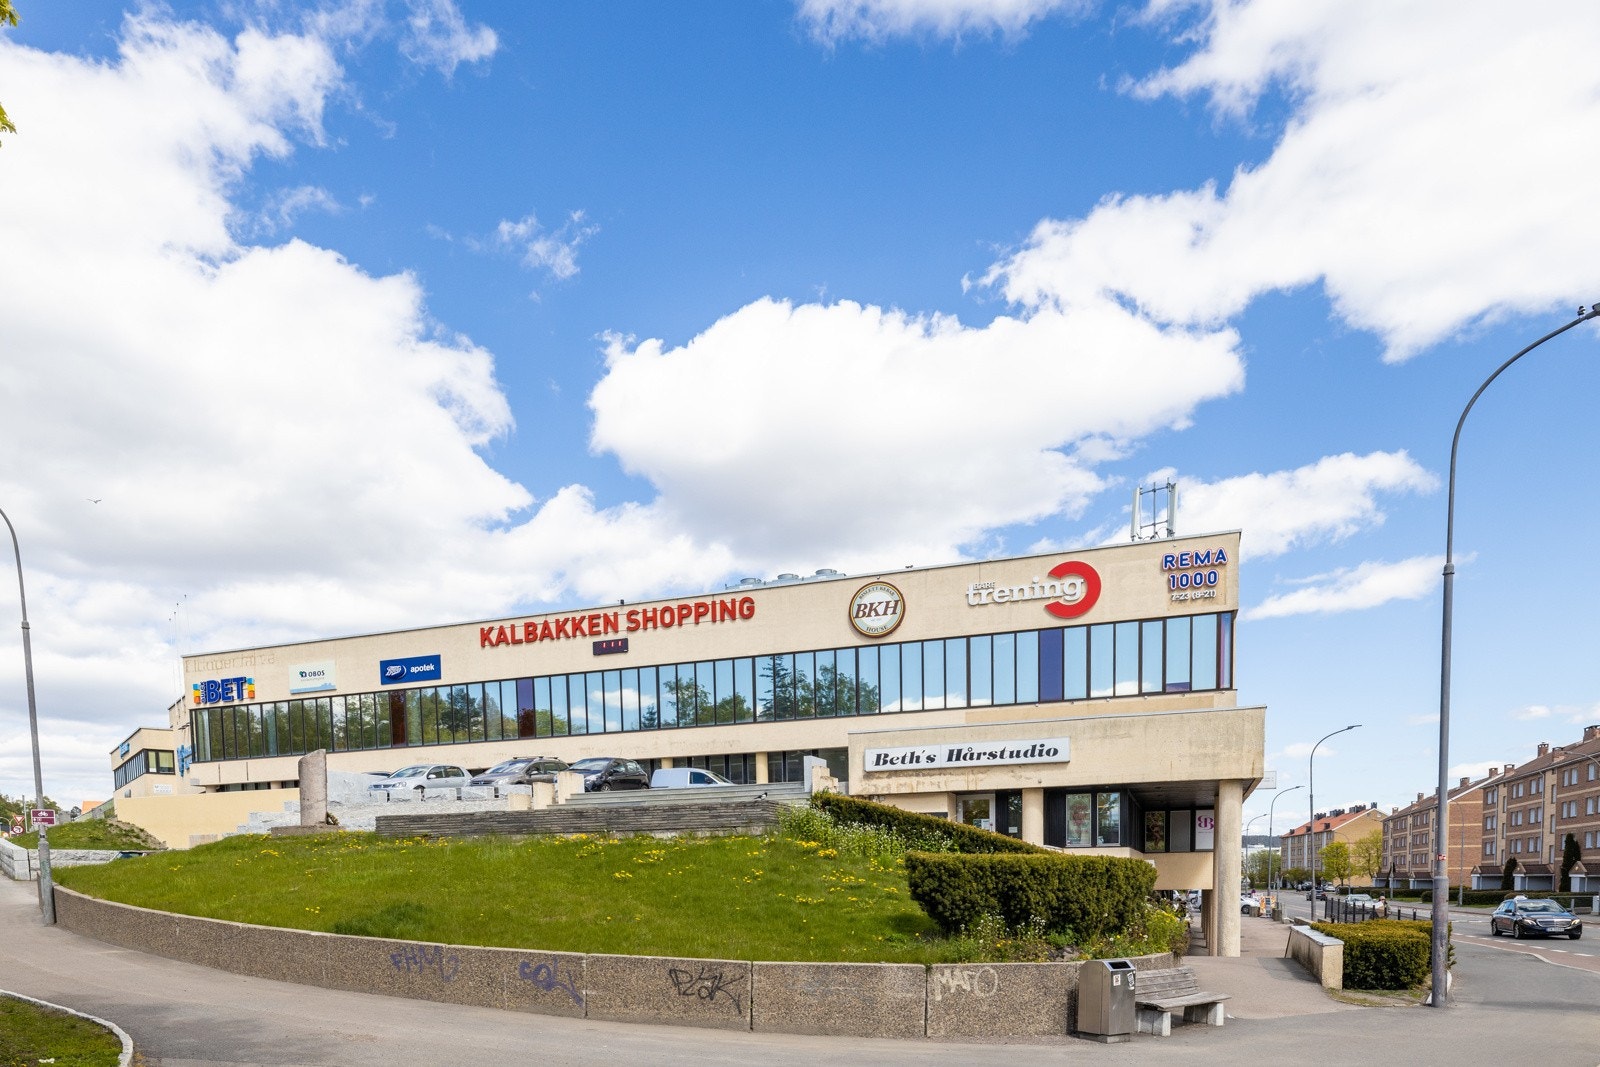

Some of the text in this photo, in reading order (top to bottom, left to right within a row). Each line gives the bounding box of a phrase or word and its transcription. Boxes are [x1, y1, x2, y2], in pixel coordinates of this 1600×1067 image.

[1162, 547, 1228, 570] REMA
[1168, 569, 1219, 590] 1000
[966, 576, 1085, 606] trening
[1171, 592, 1190, 601] 7-23
[854, 600, 901, 619] BKH
[480, 596, 756, 648] KALBAKKEN SHOPPING
[308, 670, 325, 678] OBOS
[411, 663, 435, 674] apotek
[207, 677, 247, 704] BET
[946, 743, 1059, 763] Hårstudio
